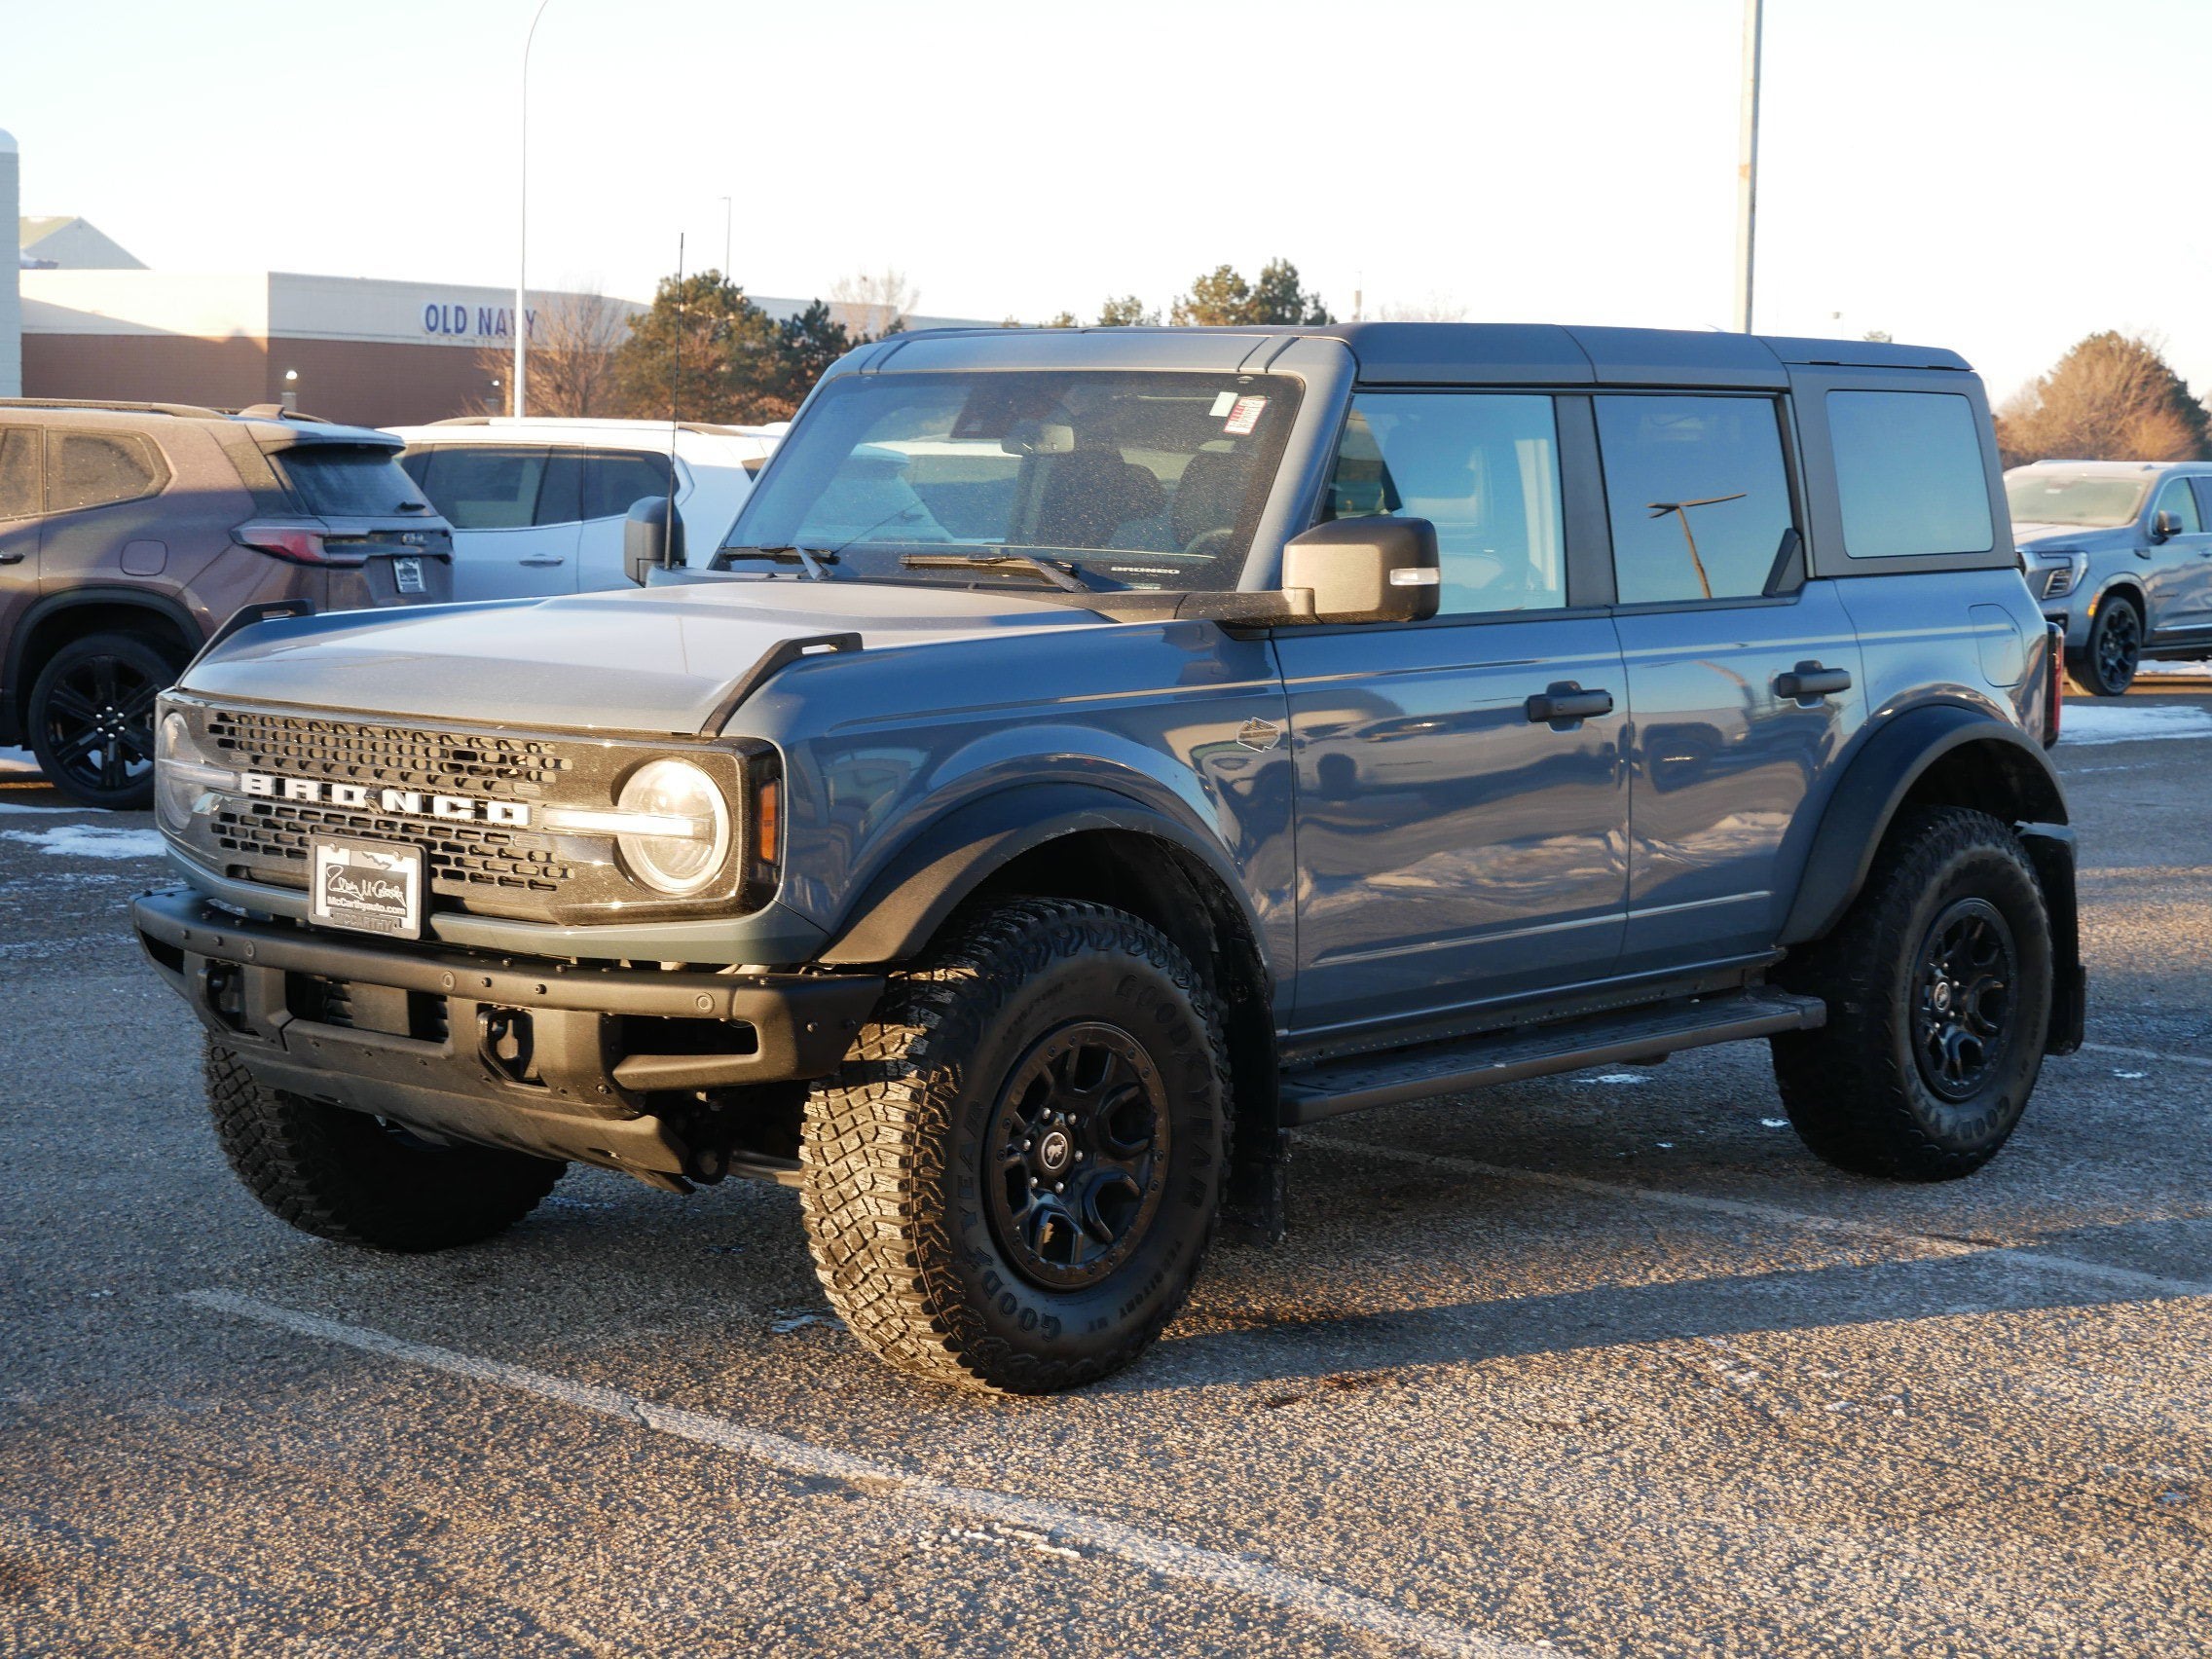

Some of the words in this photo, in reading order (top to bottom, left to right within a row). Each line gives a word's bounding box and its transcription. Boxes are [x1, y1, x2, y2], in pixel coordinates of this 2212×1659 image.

[425, 304, 467, 334] OLD
[241, 772, 533, 827] BRONCO
[327, 895, 406, 915] McCarthyauto.com
[1115, 973, 1214, 1209] GOODYEAR
